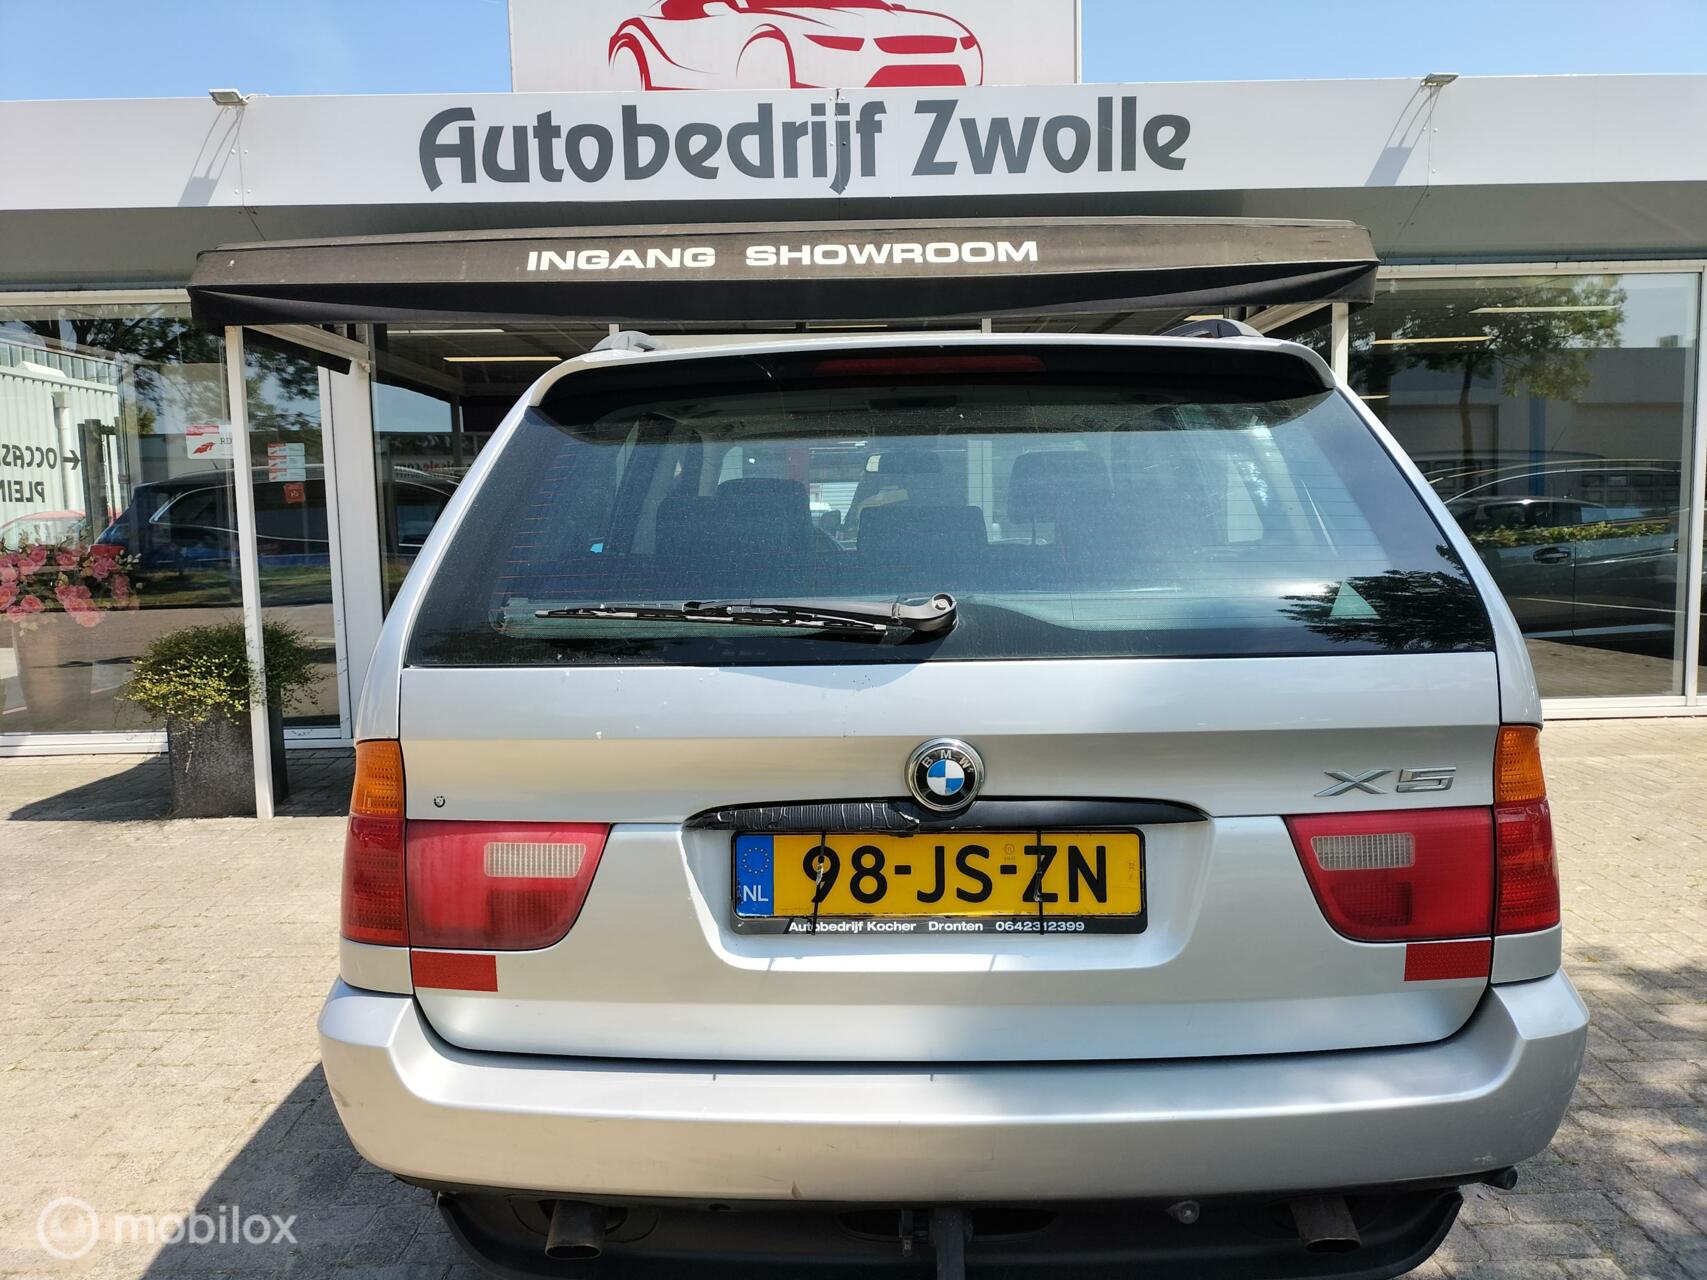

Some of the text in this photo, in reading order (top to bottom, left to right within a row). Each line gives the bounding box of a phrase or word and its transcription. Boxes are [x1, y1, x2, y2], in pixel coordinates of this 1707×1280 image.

[419, 96, 1191, 195] Autobedrijf Zwolle
[526, 241, 1039, 271] INGANG SHOWROOM
[921, 750, 971, 769] BMW
[1313, 767, 1456, 797] X5
[742, 885, 769, 902] NL
[802, 845, 1108, 904] 98-JS-ZN
[867, 921, 917, 931] Kocher
[928, 921, 984, 931] Dronten
[995, 921, 1085, 931] 0642312399
